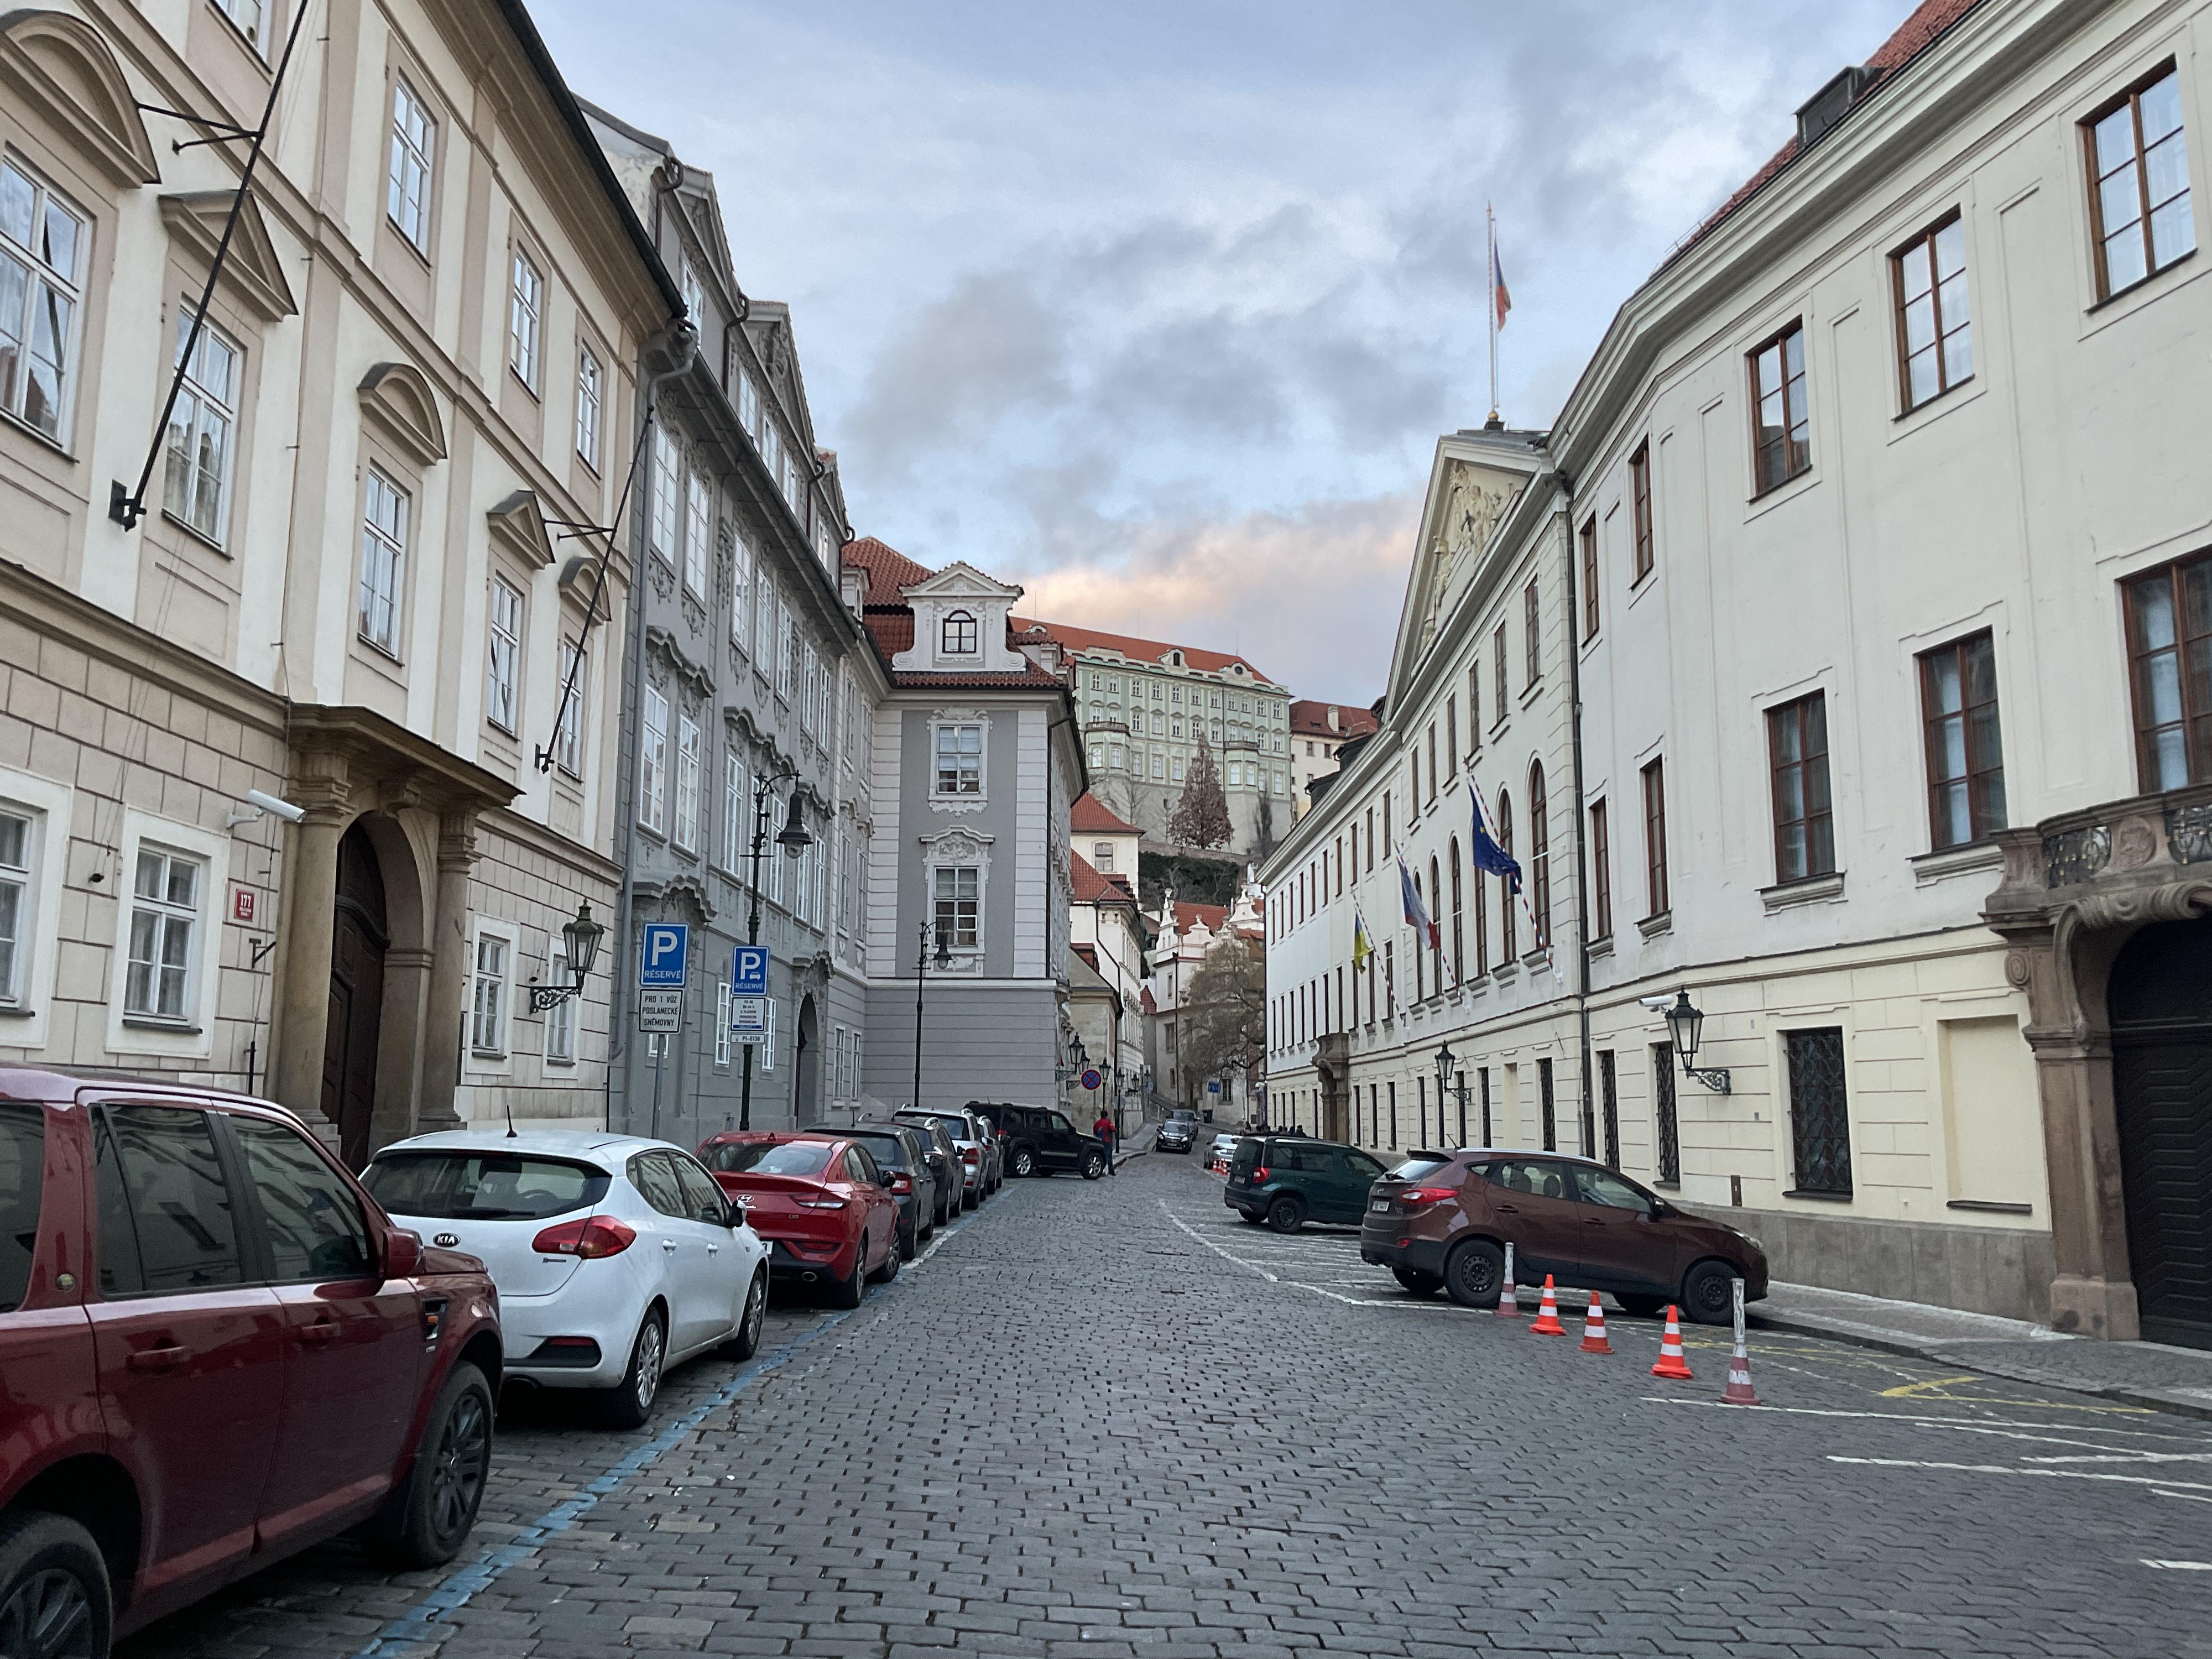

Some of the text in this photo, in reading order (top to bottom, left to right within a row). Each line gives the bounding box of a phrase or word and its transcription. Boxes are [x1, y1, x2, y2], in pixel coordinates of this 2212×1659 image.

[241, 894, 251, 907] 177
[651, 931, 677, 966] P
[740, 952, 760, 979] P
[644, 969, 681, 979] RÉSERVÉ
[642, 1006, 679, 1015] POSLANECKÉ
[437, 1235, 455, 1244] KIA
